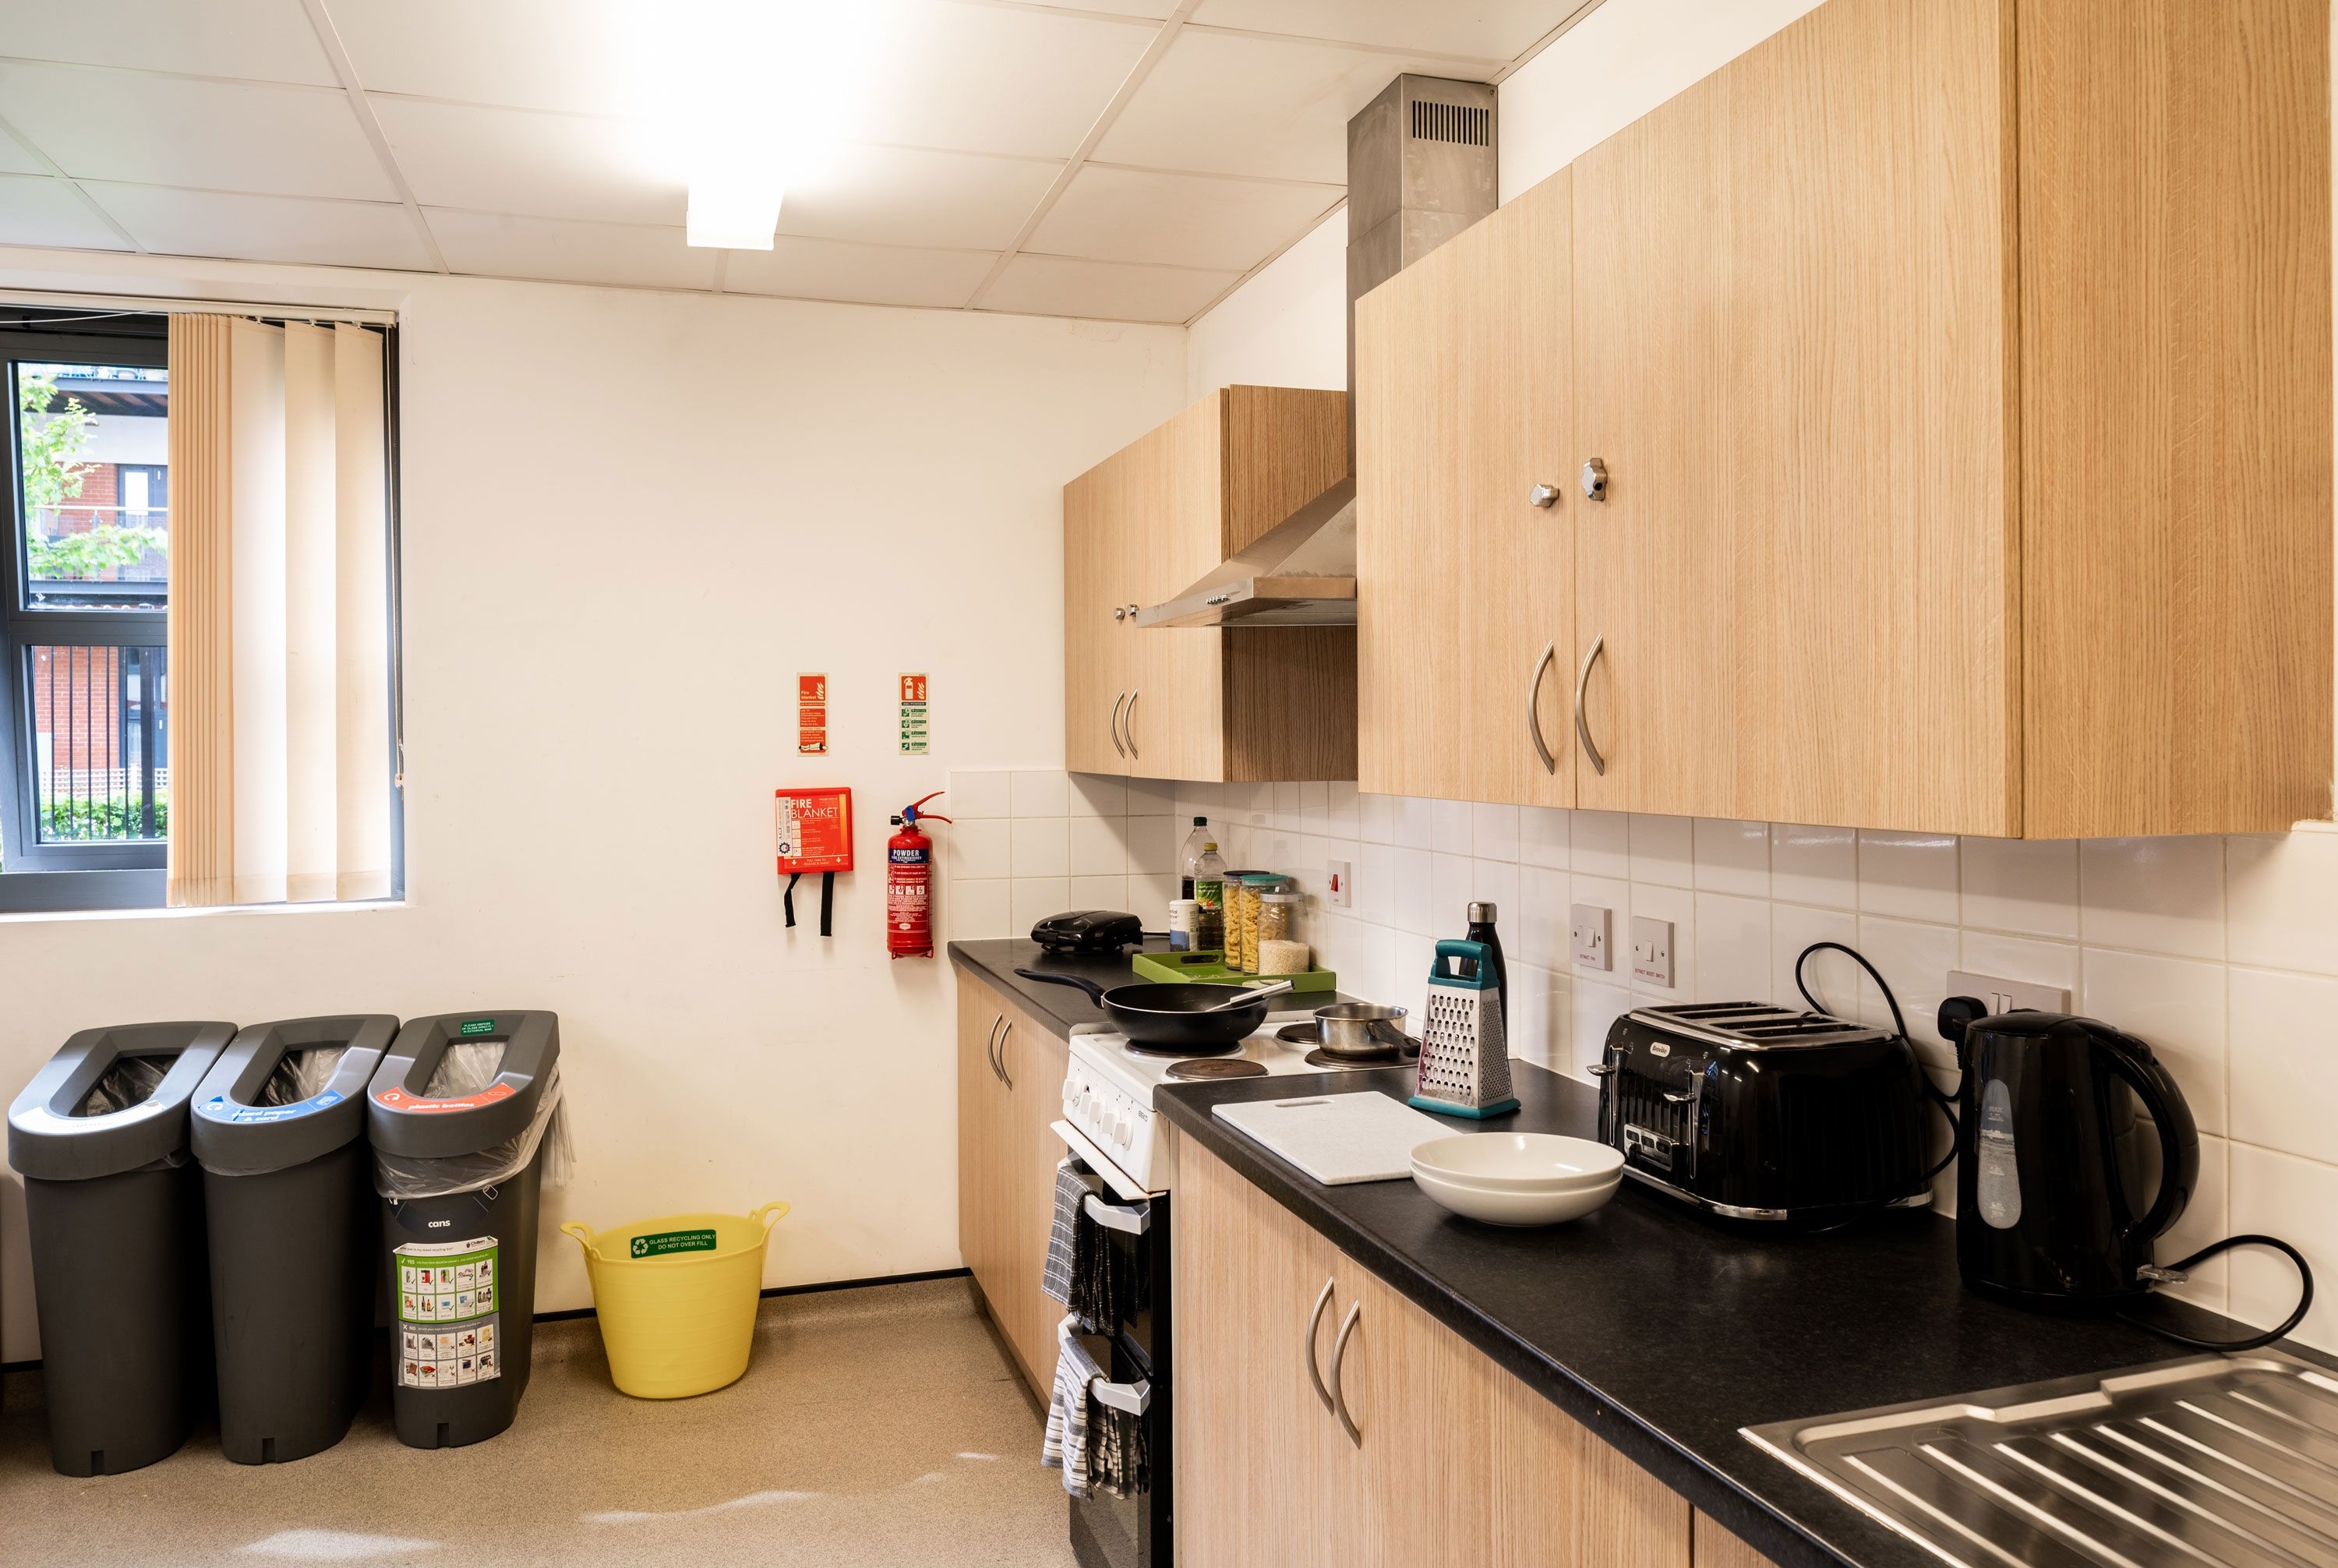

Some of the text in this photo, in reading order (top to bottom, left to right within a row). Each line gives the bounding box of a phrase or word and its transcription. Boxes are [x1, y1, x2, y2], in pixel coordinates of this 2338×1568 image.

[791, 799, 812, 809] FIRE
[791, 807, 839, 819] BLANKET
[428, 1220, 450, 1228] cans
